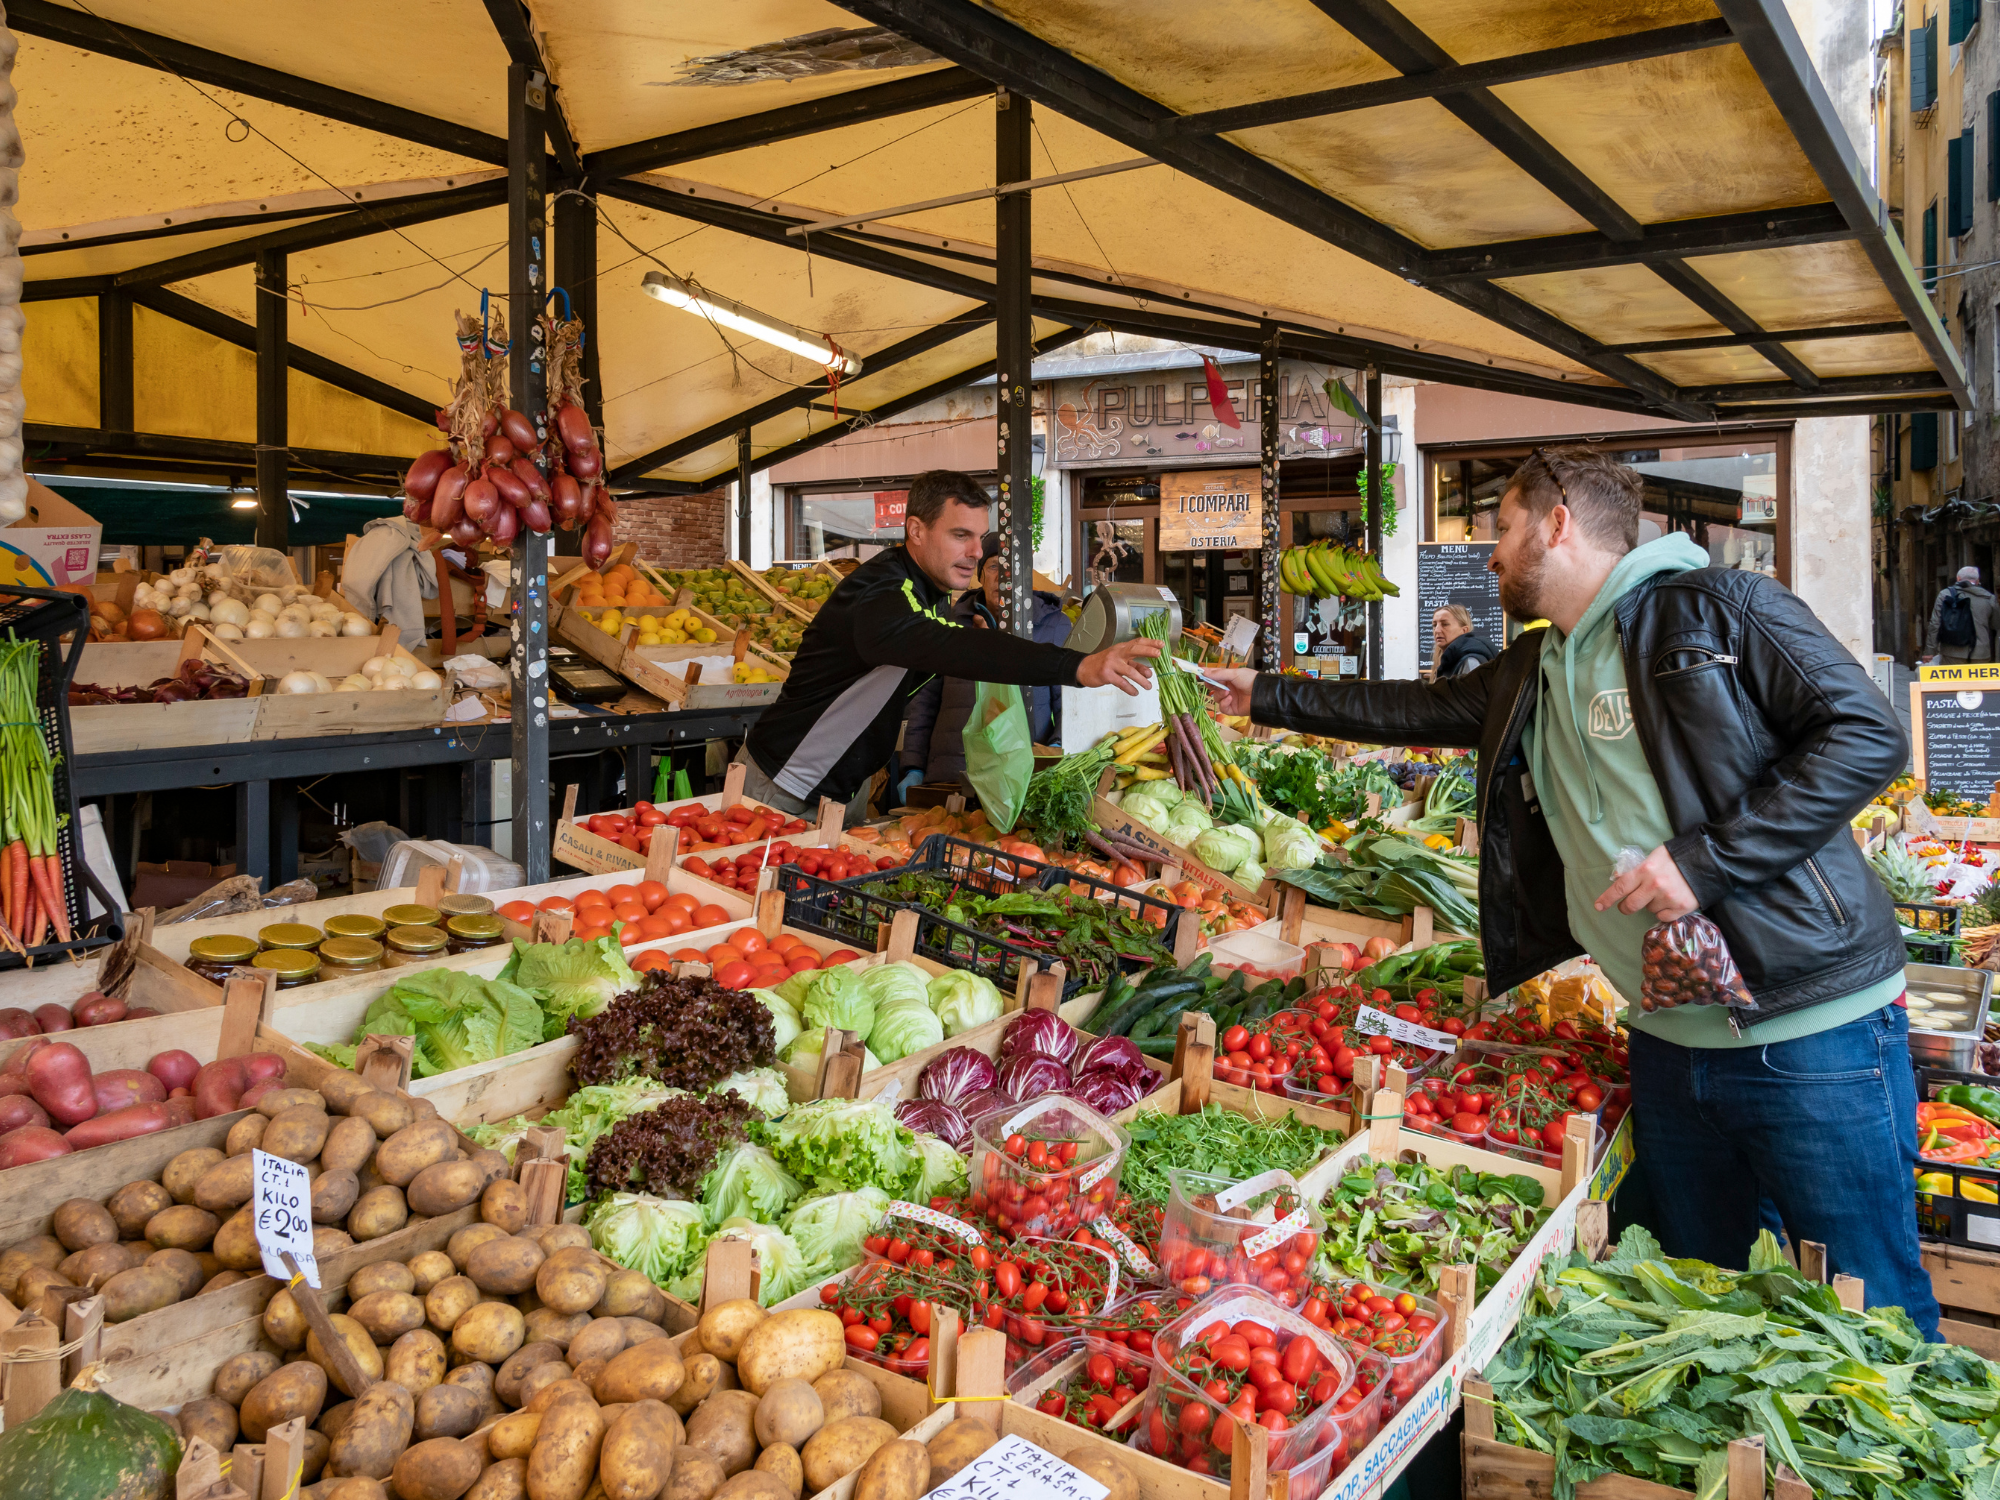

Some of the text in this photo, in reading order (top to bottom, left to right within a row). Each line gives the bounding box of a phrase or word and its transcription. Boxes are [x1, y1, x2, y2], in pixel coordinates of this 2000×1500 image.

[1178, 493, 1250, 513] I COMPARI
[1190, 535, 1238, 547] OSTERIA
[1441, 545, 1468, 553] MENU
[1930, 669, 1962, 679] ATM
[1926, 699, 1959, 709] PASTA
[560, 832, 593, 856] CASALI
[595, 849, 603, 859] &
[1174, 854, 1233, 896] UTTALTED
[263, 1187, 299, 1208] KILO
[261, 1243, 315, 1264] OLADA
[1364, 1386, 1440, 1481] SACCAGNANA
[961, 1475, 1012, 1500] KIL
